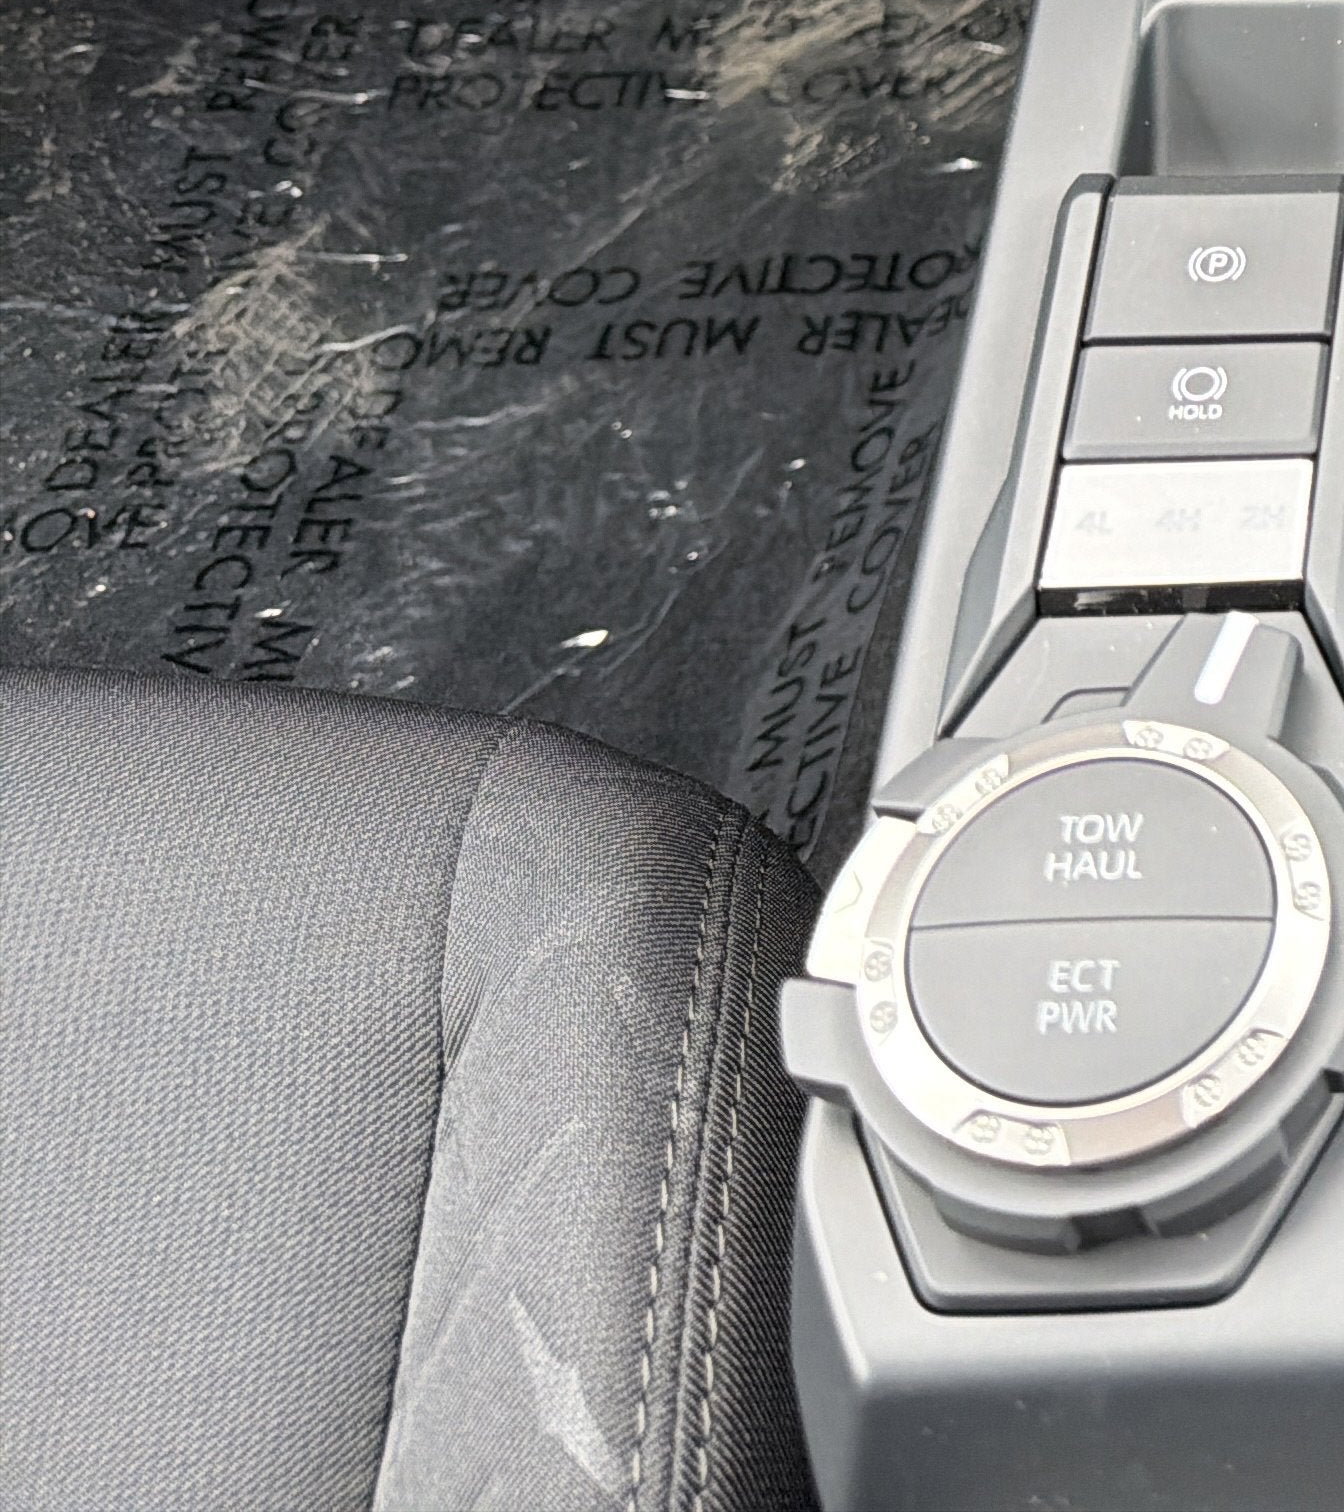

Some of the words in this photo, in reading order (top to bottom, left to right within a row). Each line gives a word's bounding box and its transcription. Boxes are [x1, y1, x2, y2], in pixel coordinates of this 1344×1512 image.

[587, 315, 761, 362] MUST
[1168, 403, 1224, 420] HOLD
[847, 422, 941, 615] COVER
[1074, 510, 1113, 536] 4L
[745, 617, 828, 773] MUST
[1060, 812, 1144, 844] TOW
[1044, 850, 1144, 883] HAUL
[1050, 959, 1121, 994] ECT
[1037, 999, 1118, 1035] PWR
